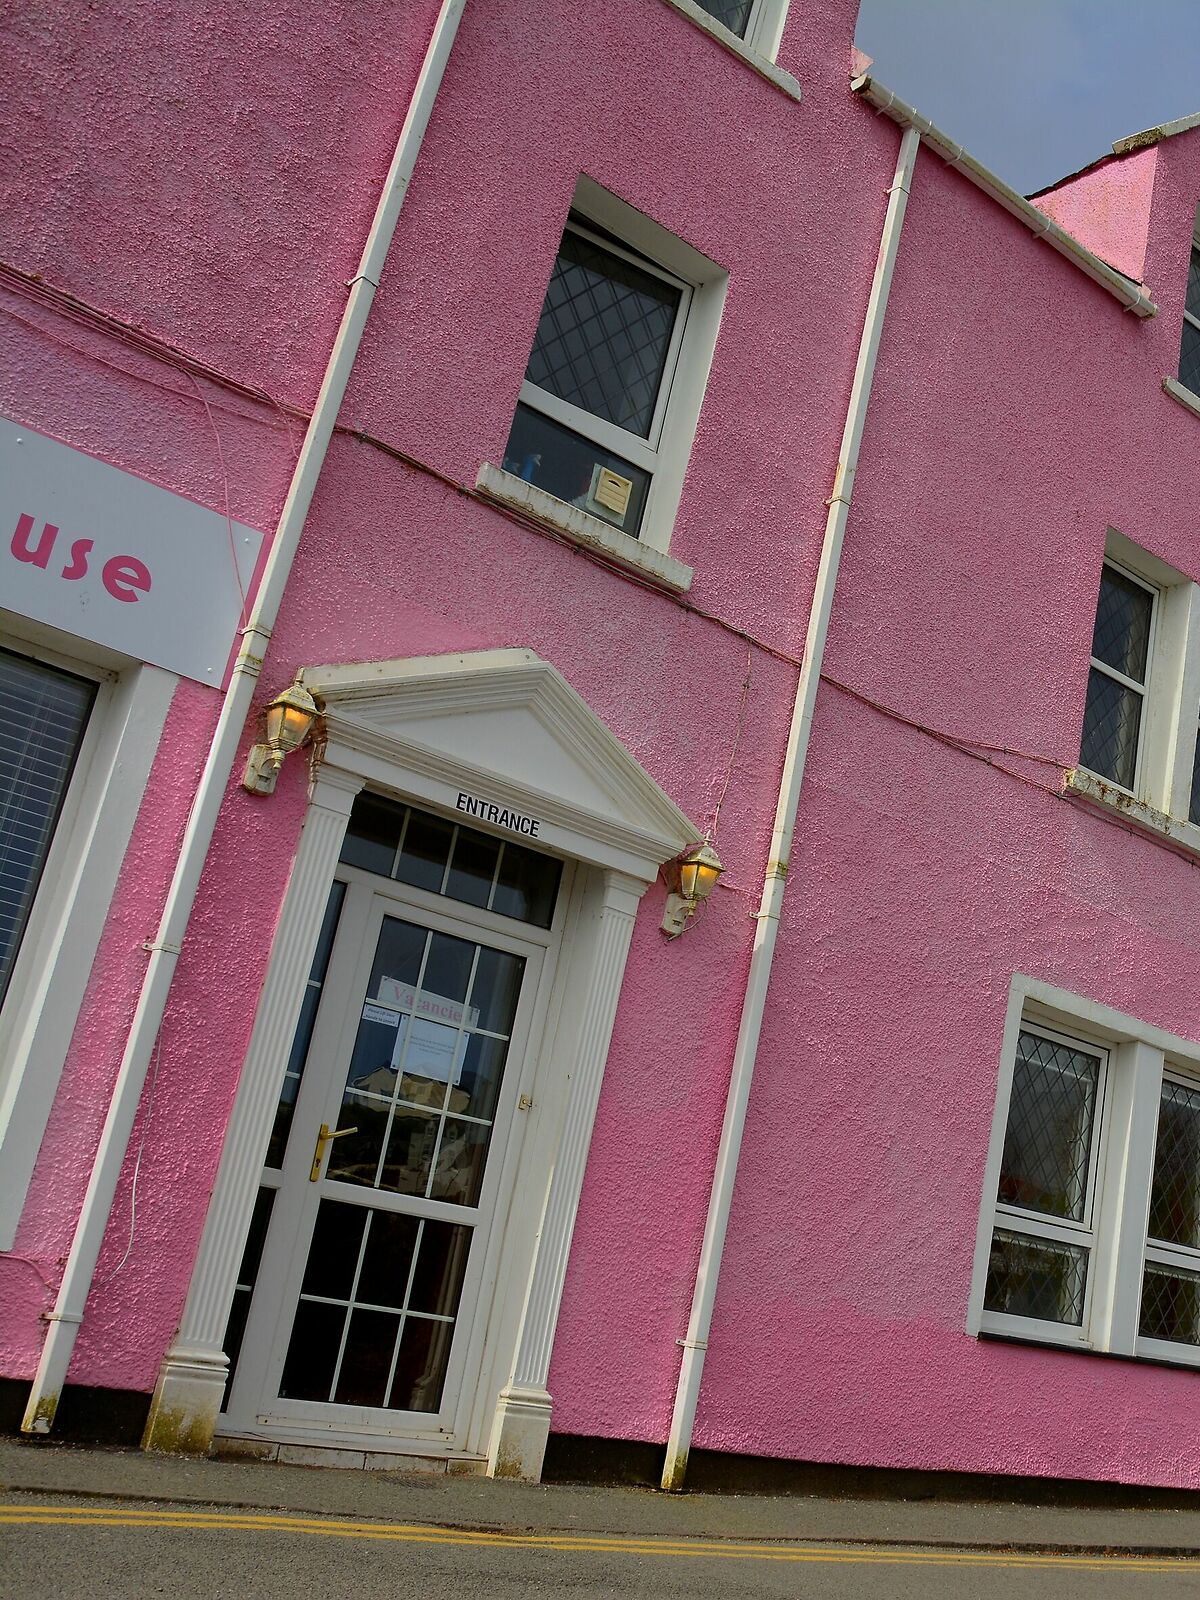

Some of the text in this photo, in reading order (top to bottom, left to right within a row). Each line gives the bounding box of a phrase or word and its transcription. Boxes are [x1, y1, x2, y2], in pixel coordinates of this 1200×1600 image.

[11, 513, 152, 602] use
[456, 793, 540, 837] ENTRANCE
[393, 985, 465, 1022] Vaancie
